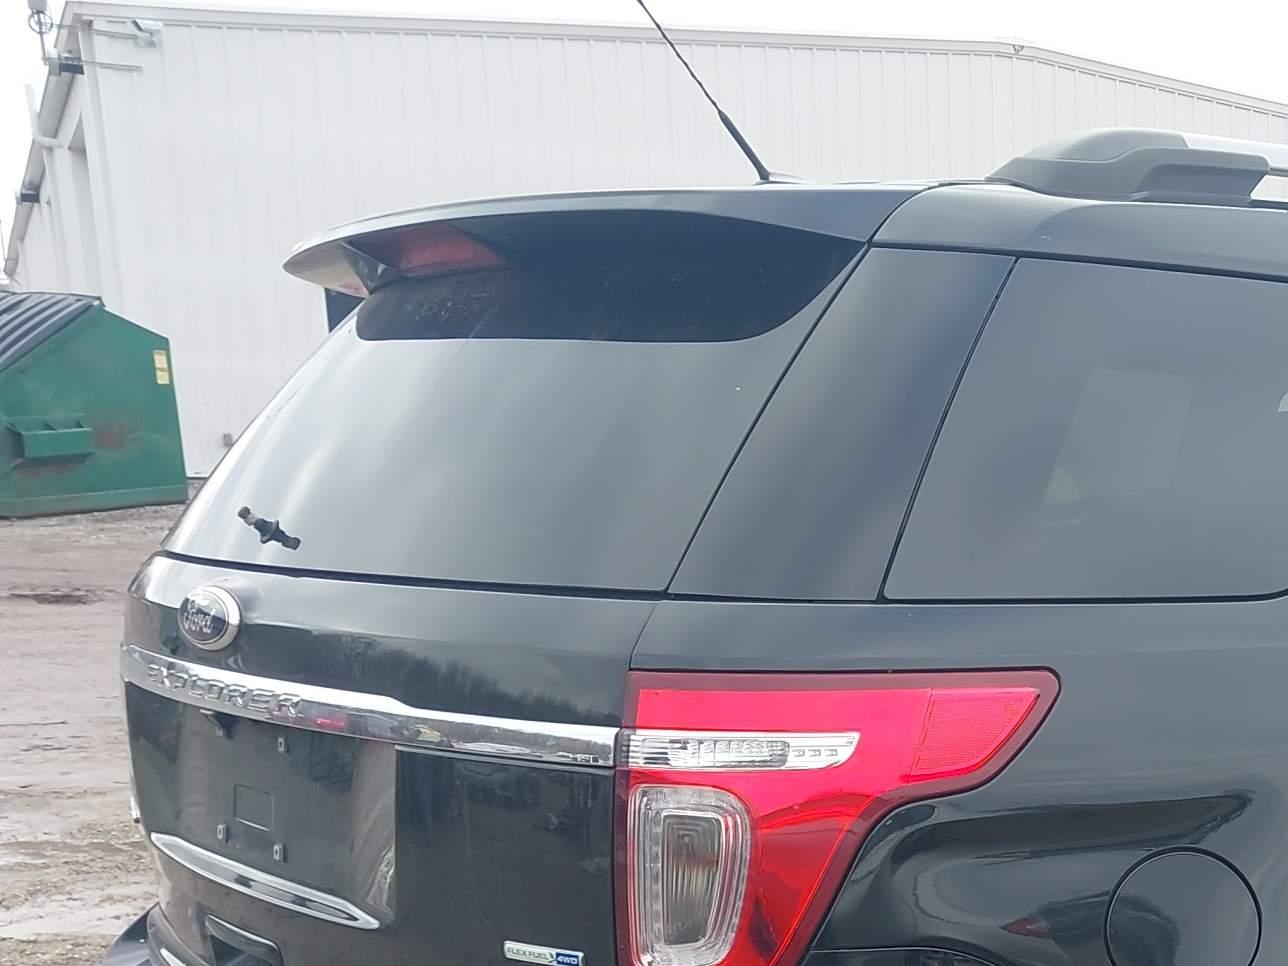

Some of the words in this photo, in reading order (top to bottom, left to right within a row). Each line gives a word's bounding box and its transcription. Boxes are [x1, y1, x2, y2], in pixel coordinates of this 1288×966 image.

[183, 600, 215, 634] Ford
[147, 664, 304, 717] EXPLORER
[506, 947, 528, 957] FLEX
[528, 951, 549, 960] FUEL
[556, 955, 578, 965] 4WD
